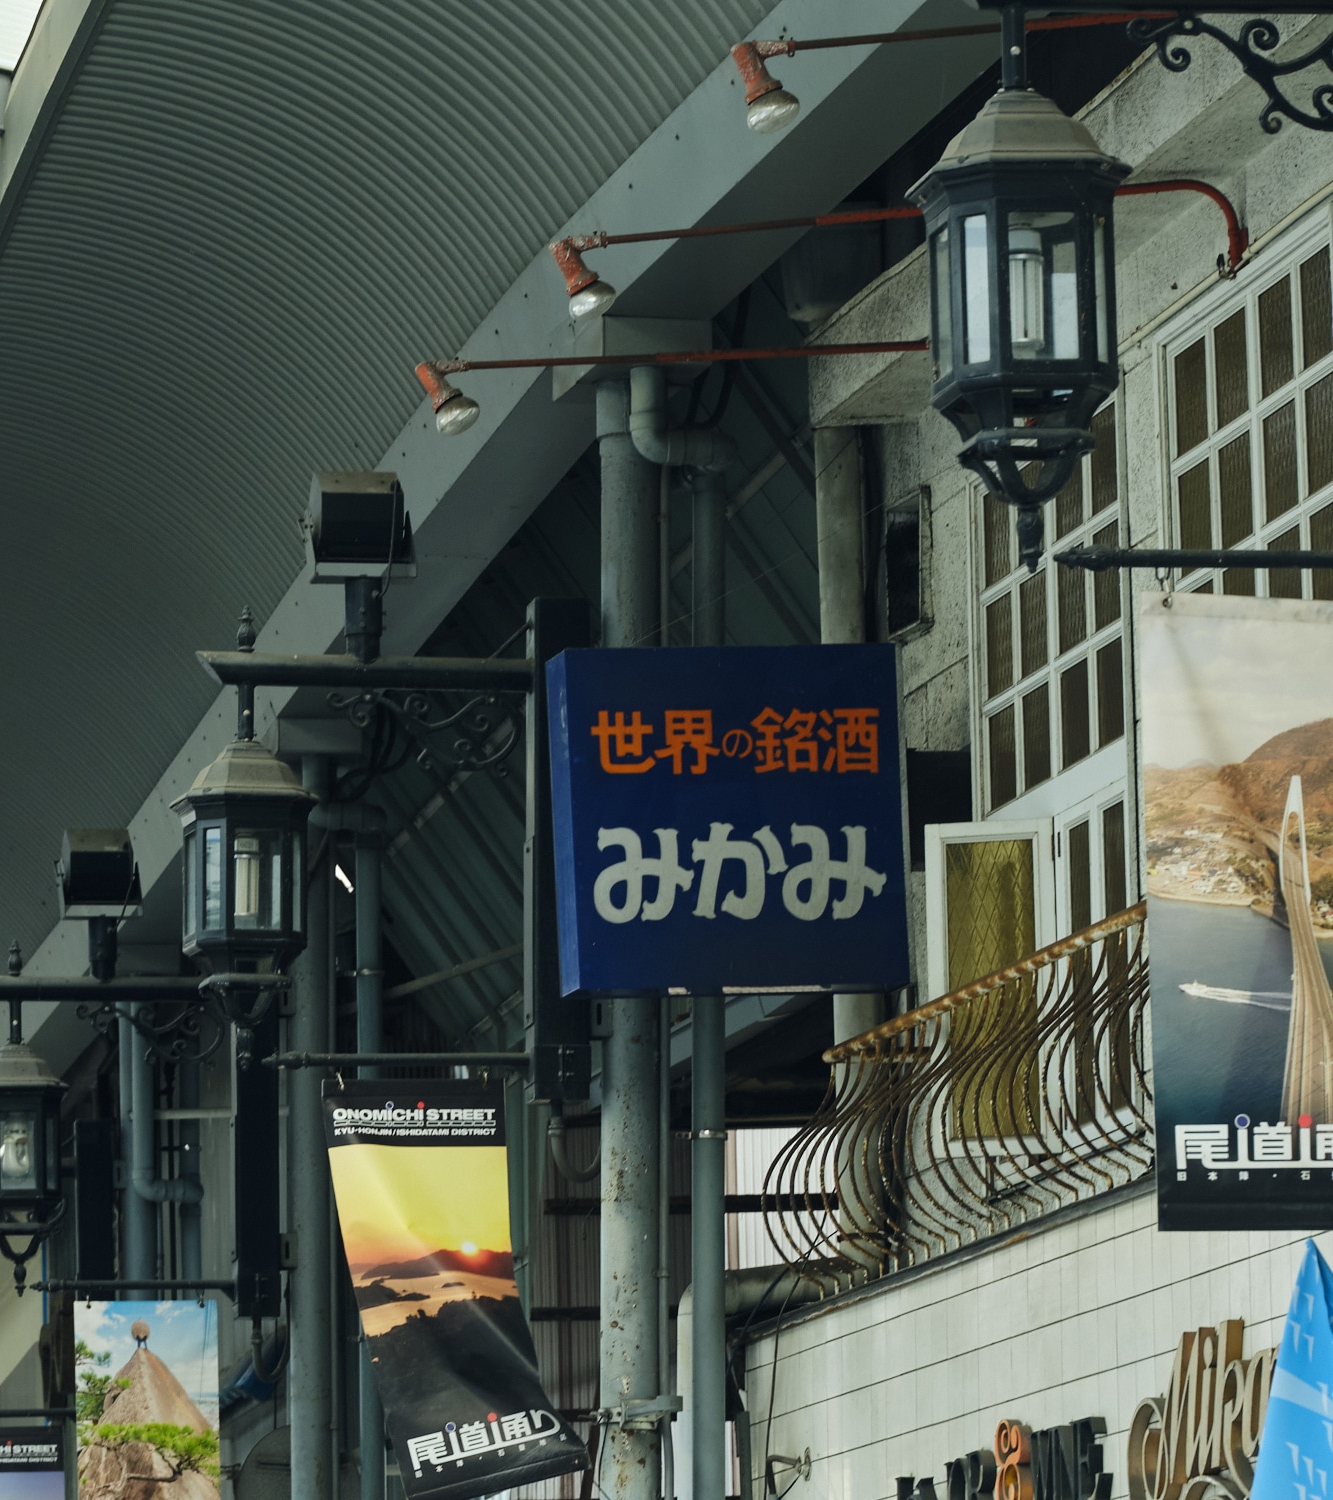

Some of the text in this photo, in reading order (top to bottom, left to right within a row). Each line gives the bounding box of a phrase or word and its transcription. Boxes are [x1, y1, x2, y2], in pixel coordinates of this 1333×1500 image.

[590, 706, 880, 775] 世界の銘酒
[593, 821, 887, 924] みかみ
[426, 1108, 496, 1120] STREET
[451, 1127, 496, 1136] DISTRICT
[13, 1444, 58, 1454] STREET
[407, 1409, 561, 1471] 尾道通り
